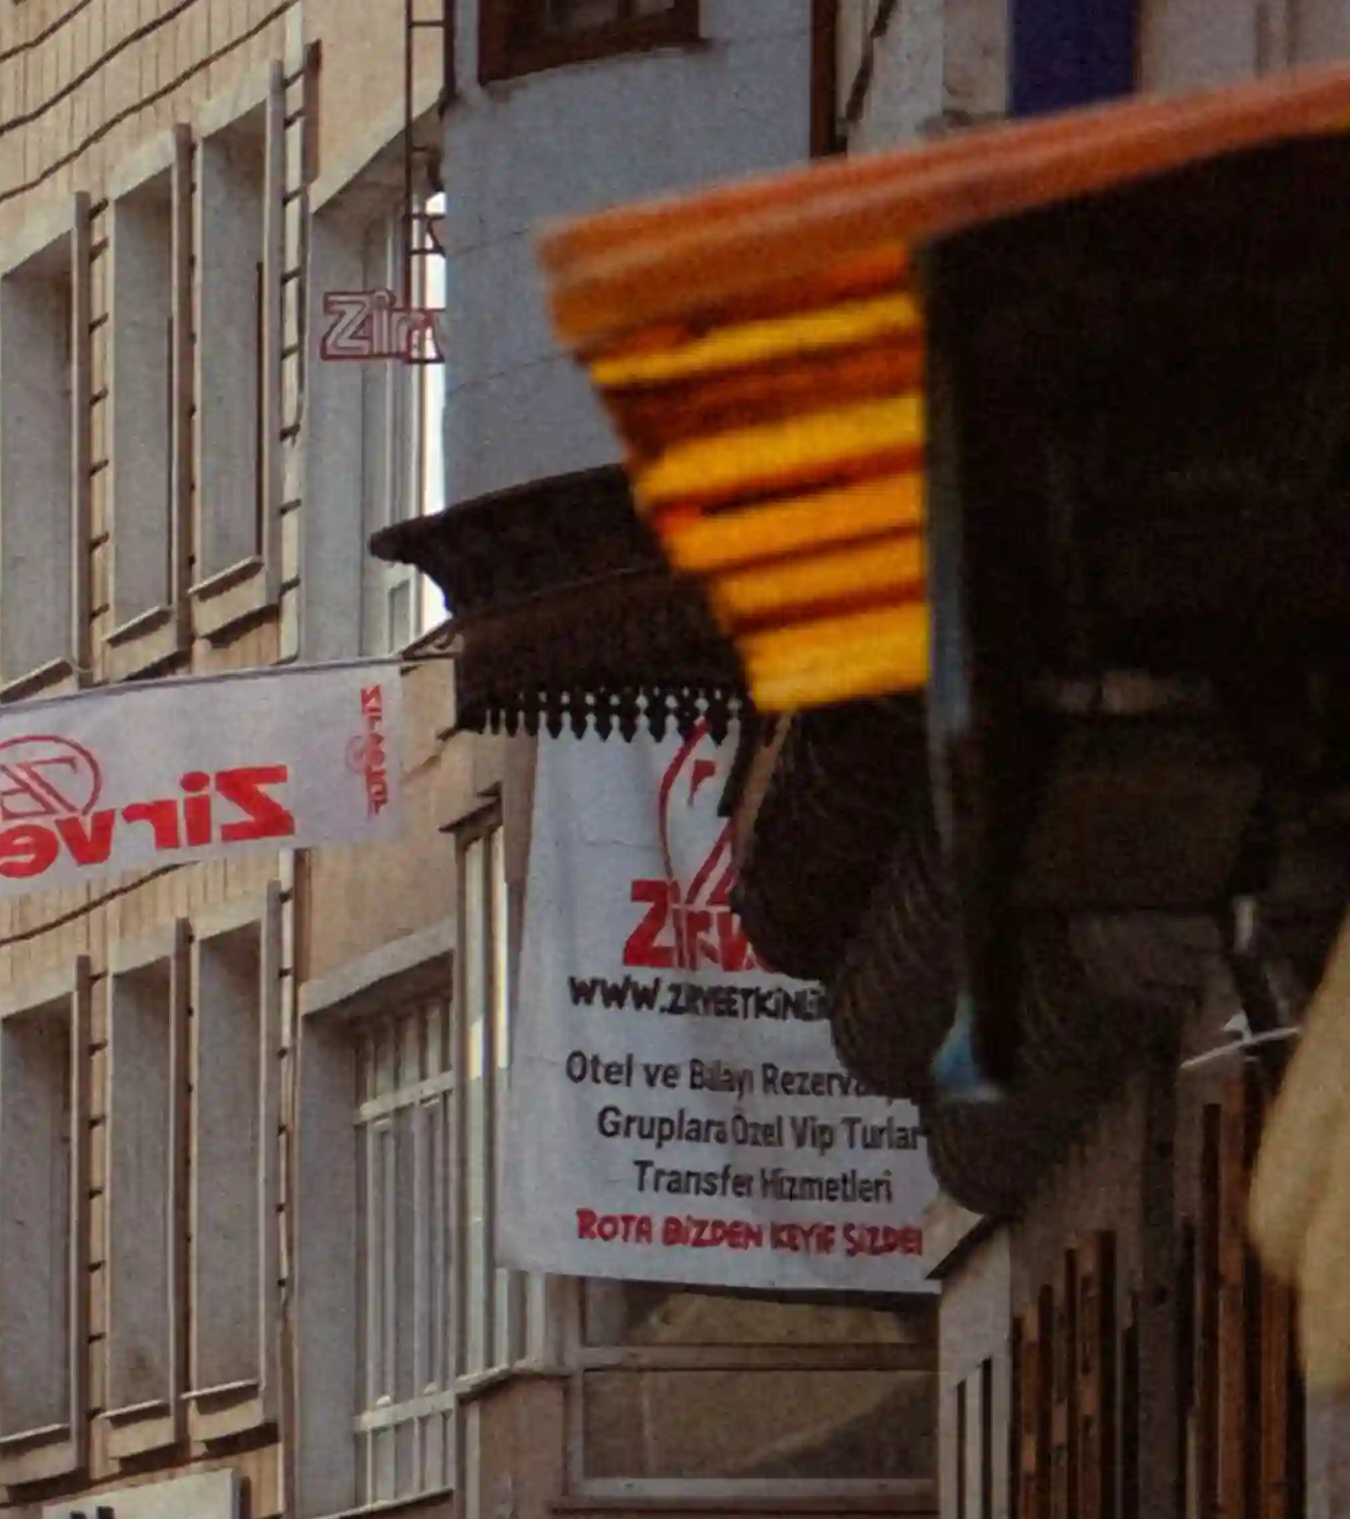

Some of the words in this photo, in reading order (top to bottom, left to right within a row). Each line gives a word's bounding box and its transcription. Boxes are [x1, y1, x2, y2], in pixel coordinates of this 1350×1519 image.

[565, 1049, 634, 1088] Otel
[643, 1062, 680, 1090] ve
[597, 1104, 728, 1150] Gruplara
[790, 1115, 836, 1157] Vip
[633, 1159, 756, 1199] Transfer
[761, 1167, 894, 1204] Hizmetleri
[575, 1207, 654, 1242] ROTA
[660, 1212, 764, 1251] BİZDEN
